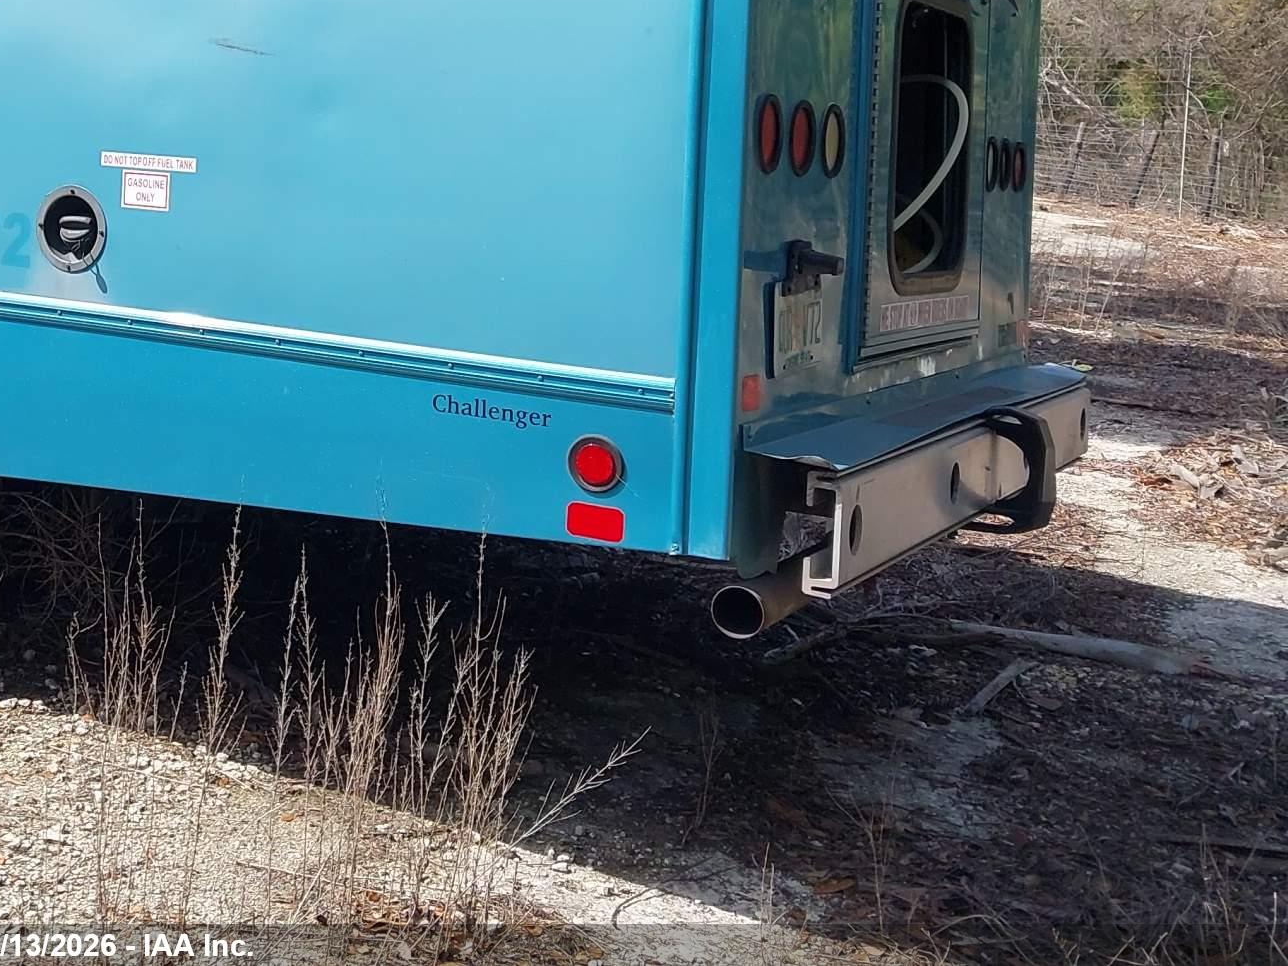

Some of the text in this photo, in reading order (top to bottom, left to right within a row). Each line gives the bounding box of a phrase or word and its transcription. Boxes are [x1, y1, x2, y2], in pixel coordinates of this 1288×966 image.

[103, 154, 194, 171] DO NOT TOP OFF FUEL TANK
[127, 177, 165, 190] GASOLINE
[135, 191, 156, 203] ONLY
[432, 395, 552, 429] Challenger
